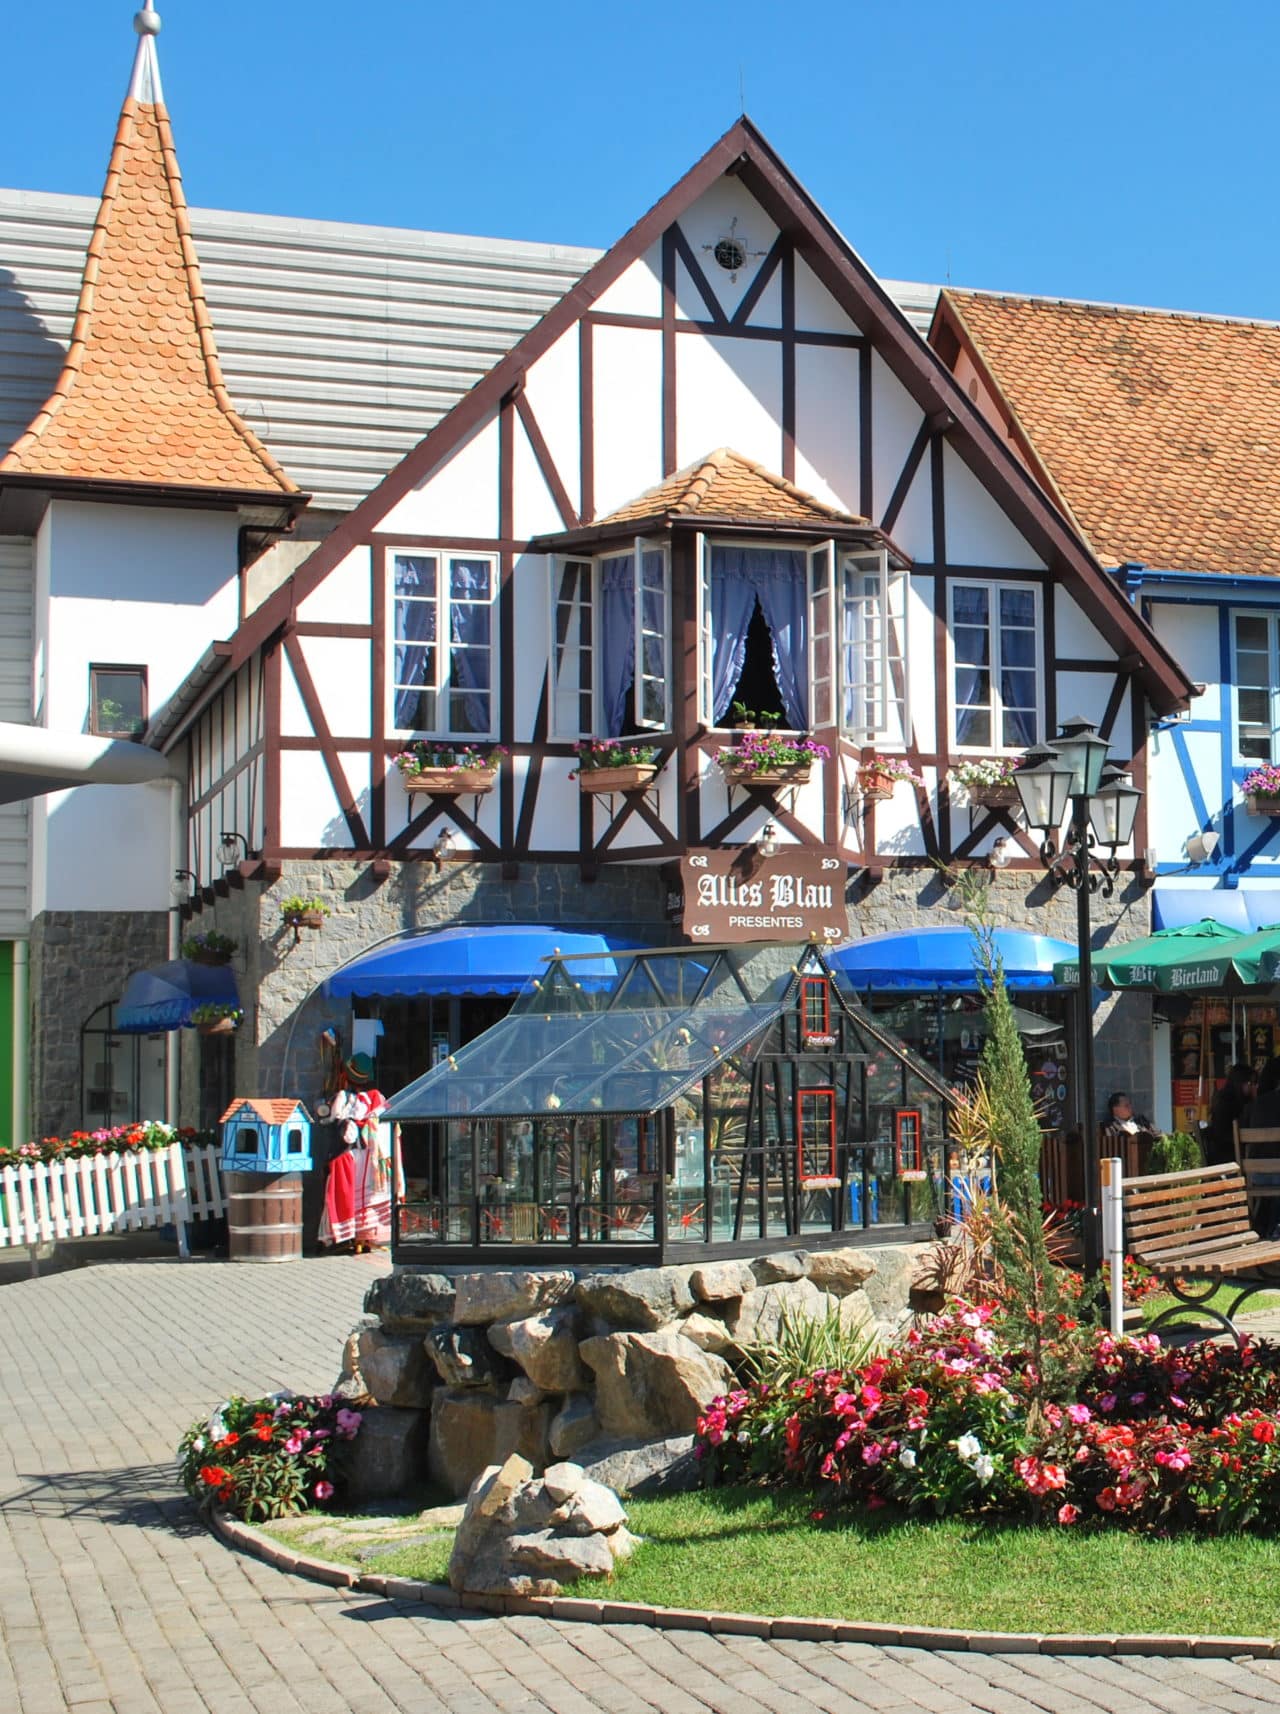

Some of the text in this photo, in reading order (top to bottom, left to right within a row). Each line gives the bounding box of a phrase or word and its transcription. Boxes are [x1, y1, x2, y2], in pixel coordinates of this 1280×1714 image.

[697, 874, 832, 912] Alles Blau
[729, 916, 803, 928] PRESENTES
[1170, 966, 1219, 990] Bierland
